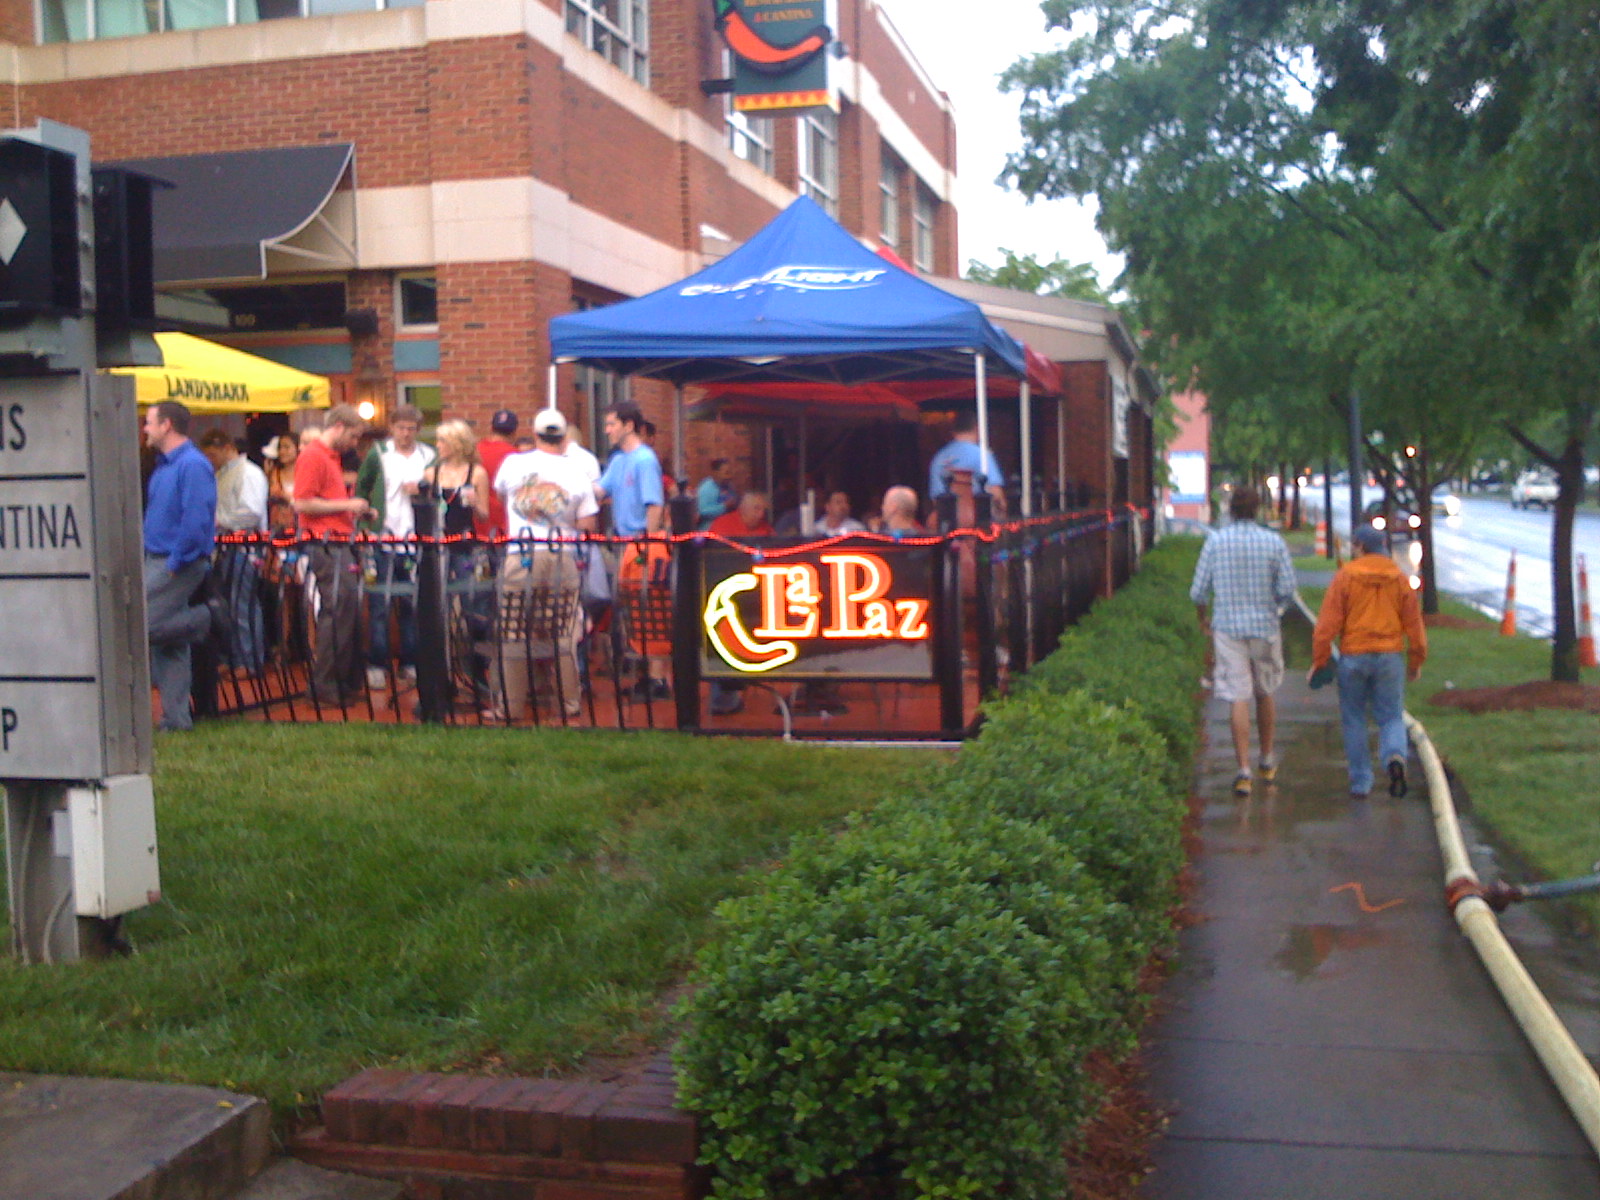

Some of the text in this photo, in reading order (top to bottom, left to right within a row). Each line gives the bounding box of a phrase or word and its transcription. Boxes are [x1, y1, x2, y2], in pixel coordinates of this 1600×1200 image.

[0, 403, 26, 450] S
[753, 552, 929, 639] La Paz
[2, 707, 18, 751] P
